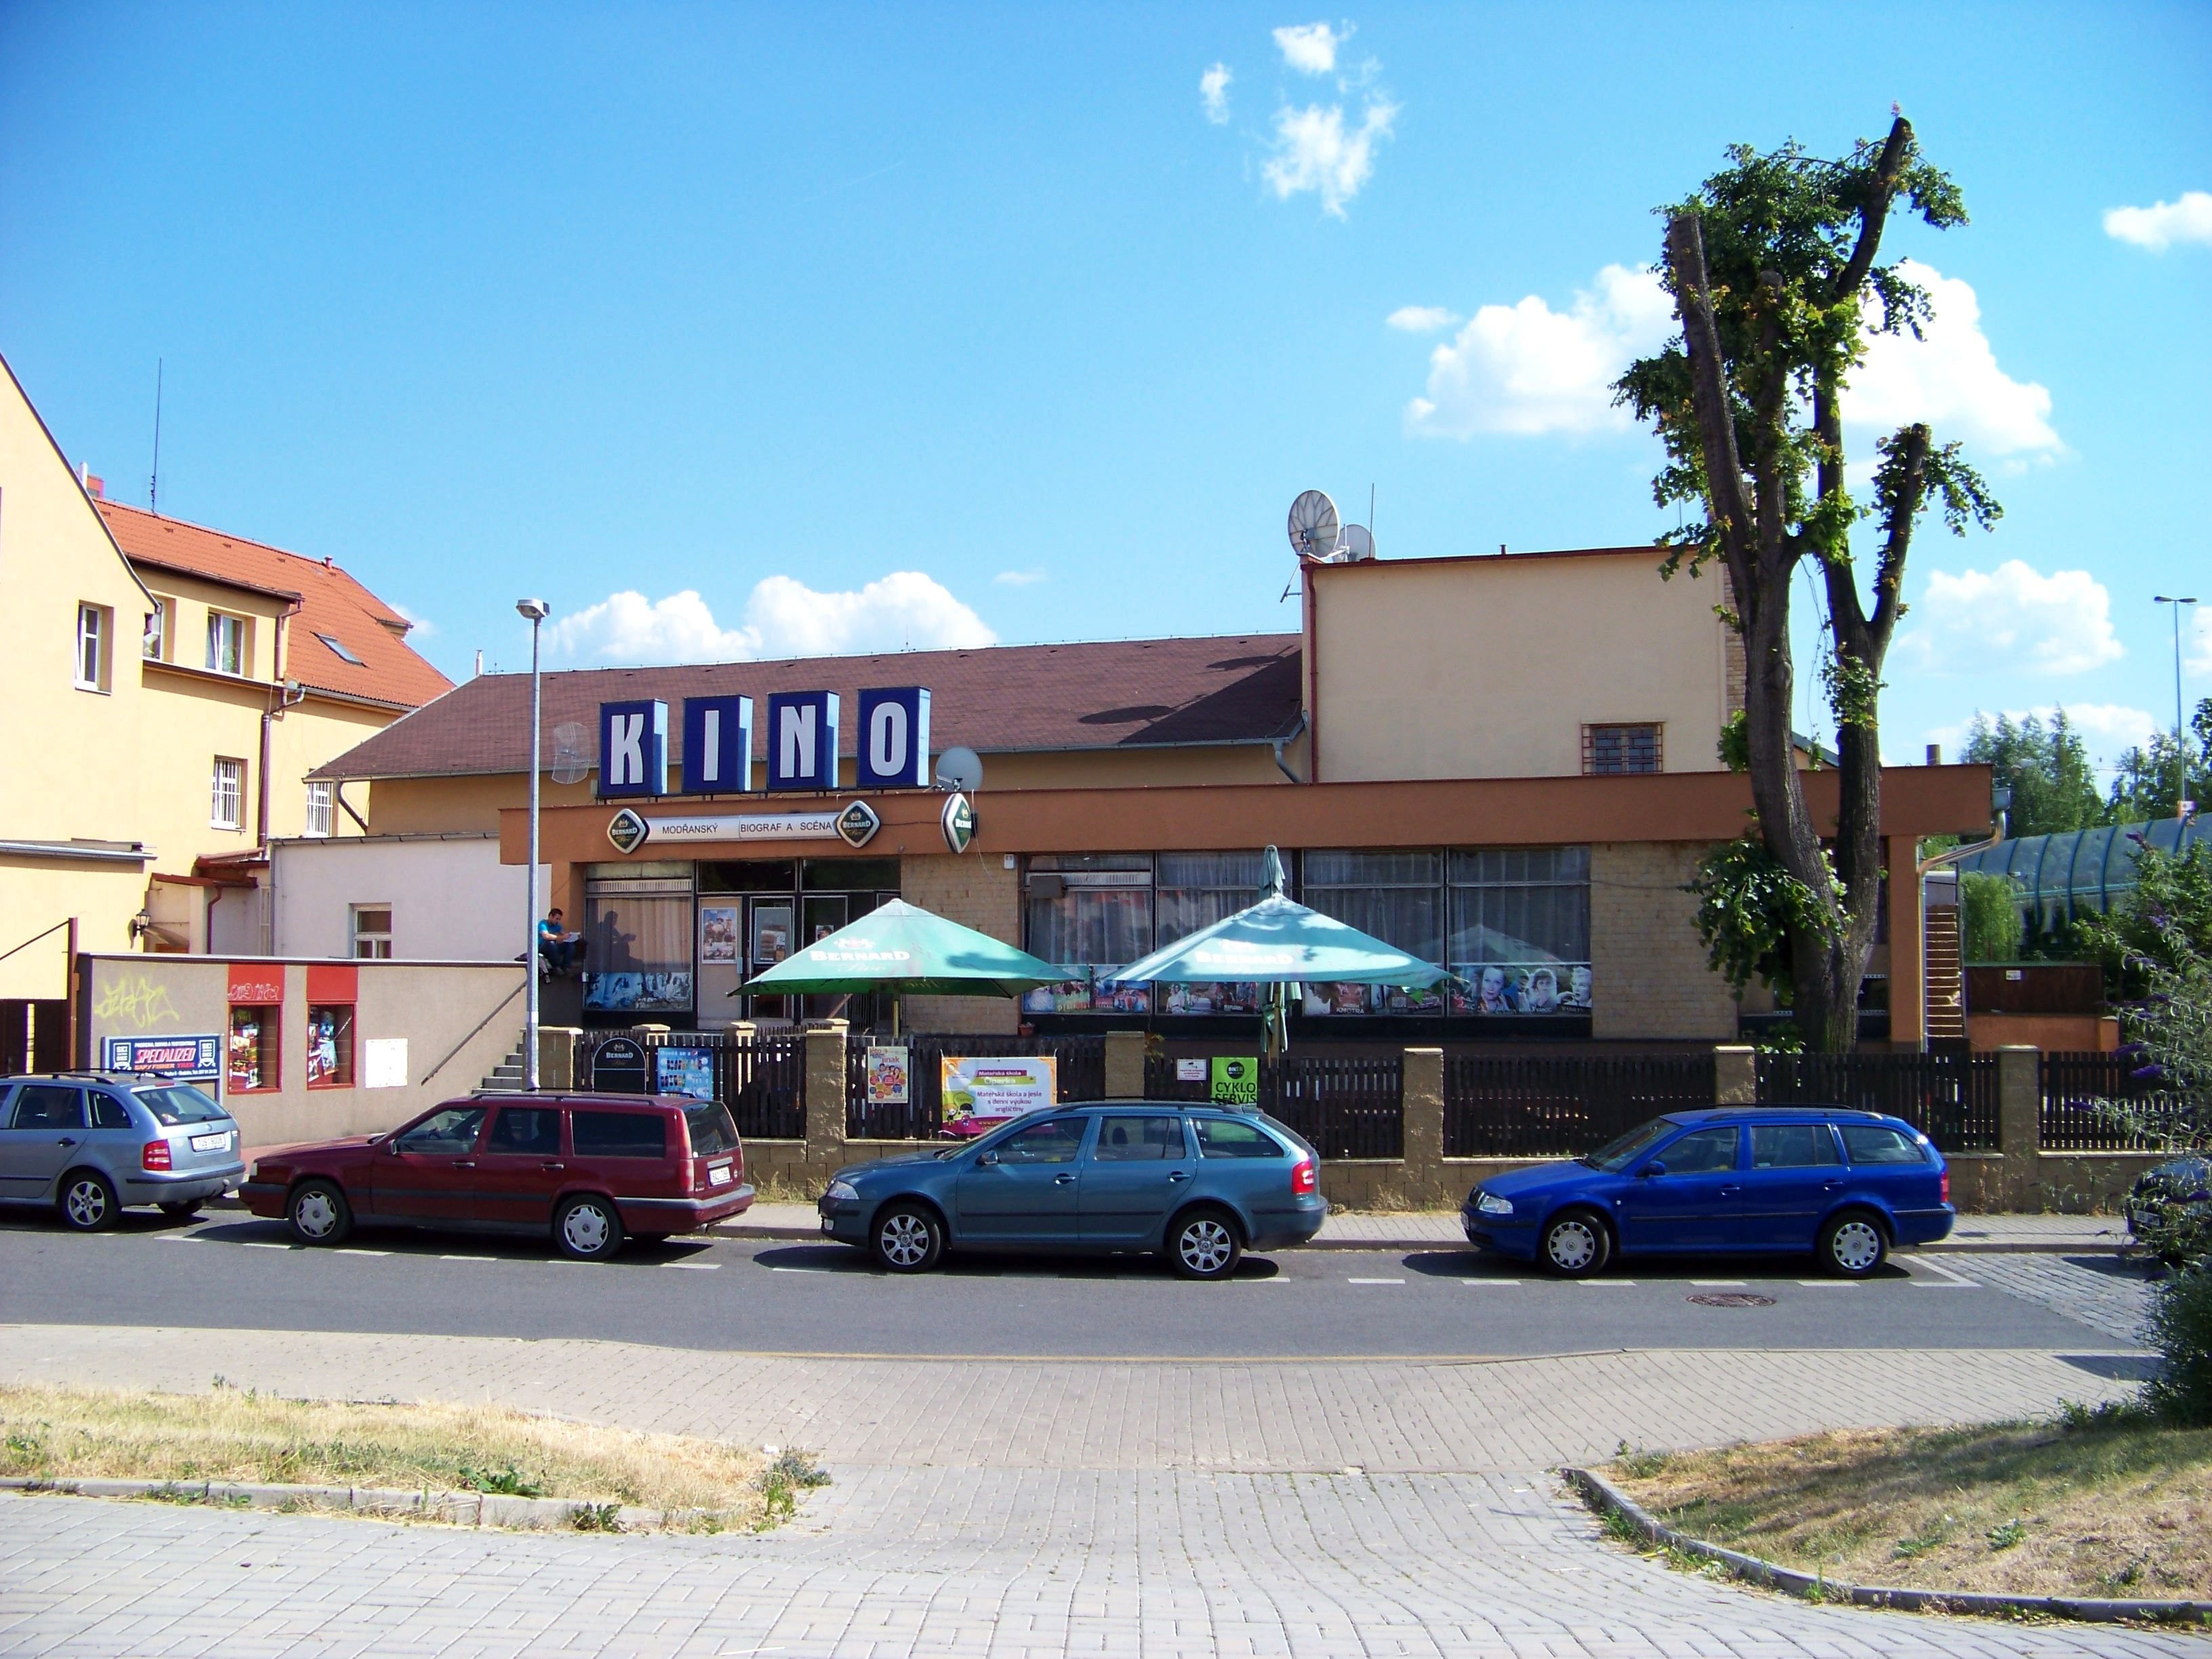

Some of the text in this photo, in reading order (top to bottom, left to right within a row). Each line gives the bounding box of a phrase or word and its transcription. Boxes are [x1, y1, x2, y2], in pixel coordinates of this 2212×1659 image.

[610, 701, 907, 785] KINO
[612, 827, 638, 836] BERNARD
[662, 823, 718, 834] MODŘANSKÝ
[741, 823, 781, 832] BIOGRAF
[800, 820, 832, 831] SCÉNA
[809, 950, 911, 961] BERNARD
[1195, 951, 1294, 965] BERNARD
[134, 1048, 197, 1064] SPECIALIZED
[1216, 1082, 1256, 1093] CYKLO
